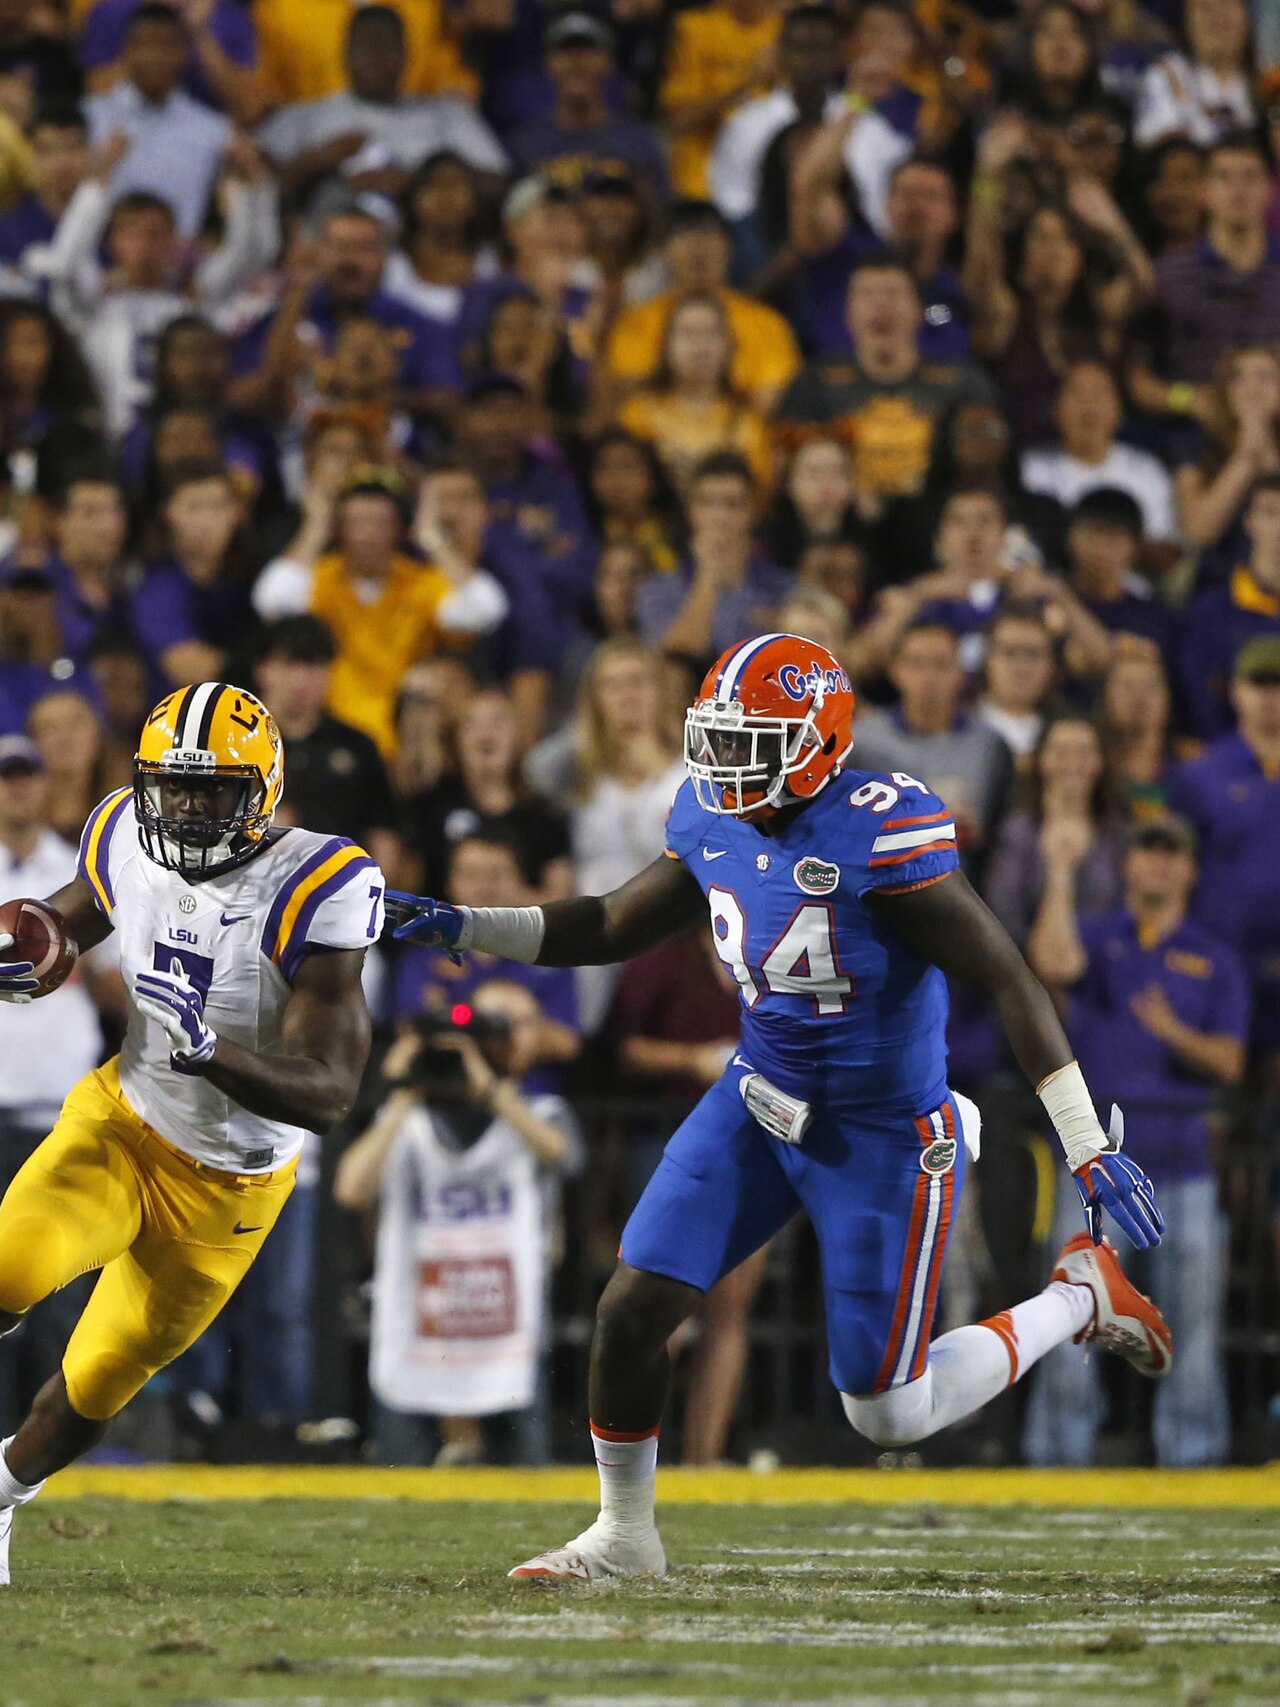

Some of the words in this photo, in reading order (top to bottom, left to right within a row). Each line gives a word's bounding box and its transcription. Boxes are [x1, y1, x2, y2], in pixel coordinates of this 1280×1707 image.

[175, 752, 203, 762] LSU
[849, 772, 930, 813] 94
[179, 896, 196, 912] SEC
[366, 885, 382, 938] 7
[169, 928, 198, 945] LSU
[708, 883, 856, 1018] 94
